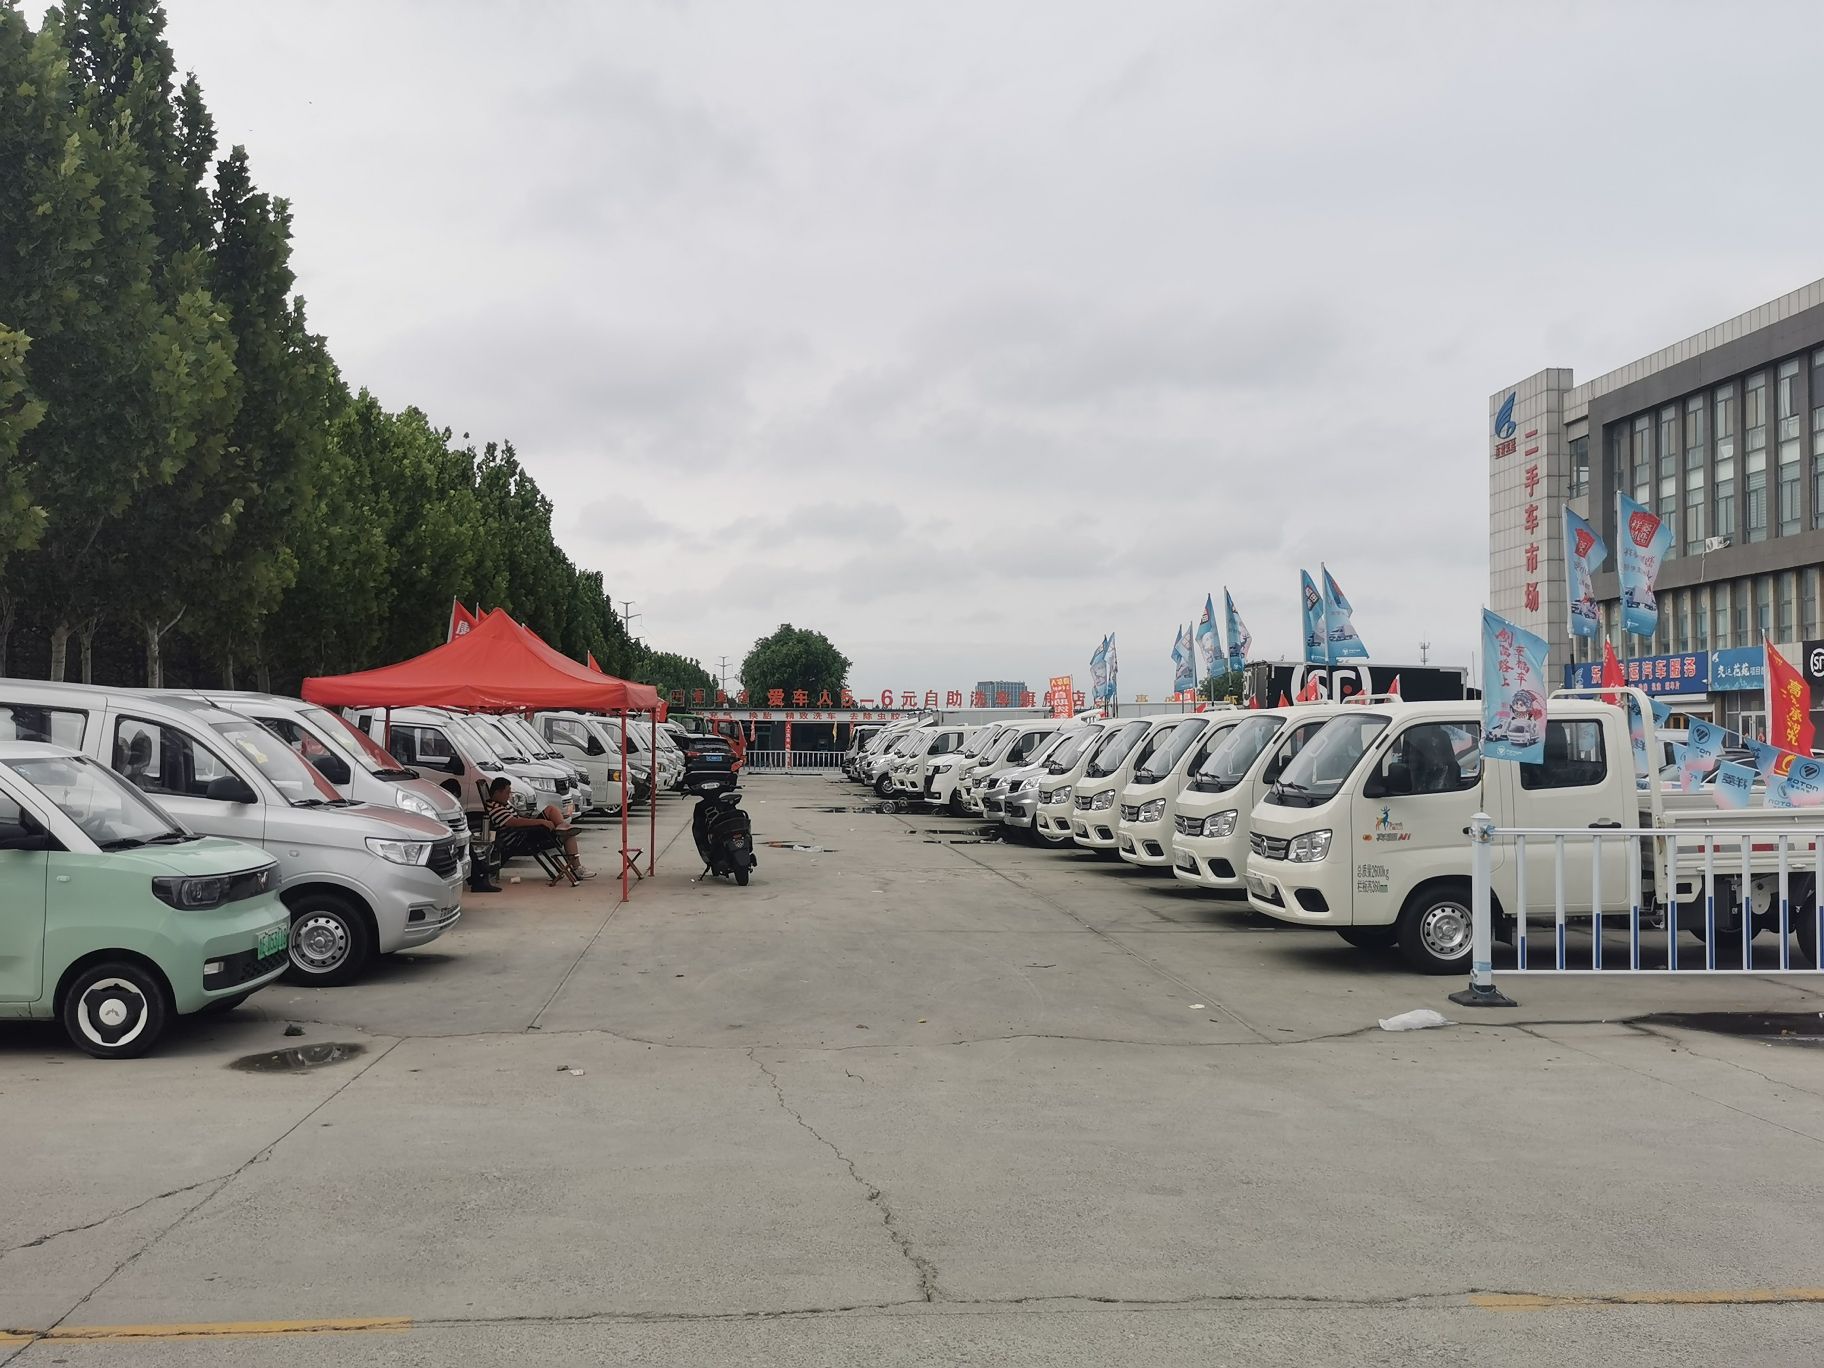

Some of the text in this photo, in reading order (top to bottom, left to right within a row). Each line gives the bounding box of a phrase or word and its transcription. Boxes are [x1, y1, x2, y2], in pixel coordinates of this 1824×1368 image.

[1524, 429, 1540, 613] 二手车市场
[1591, 657, 1696, 684] 东运汽车服务
